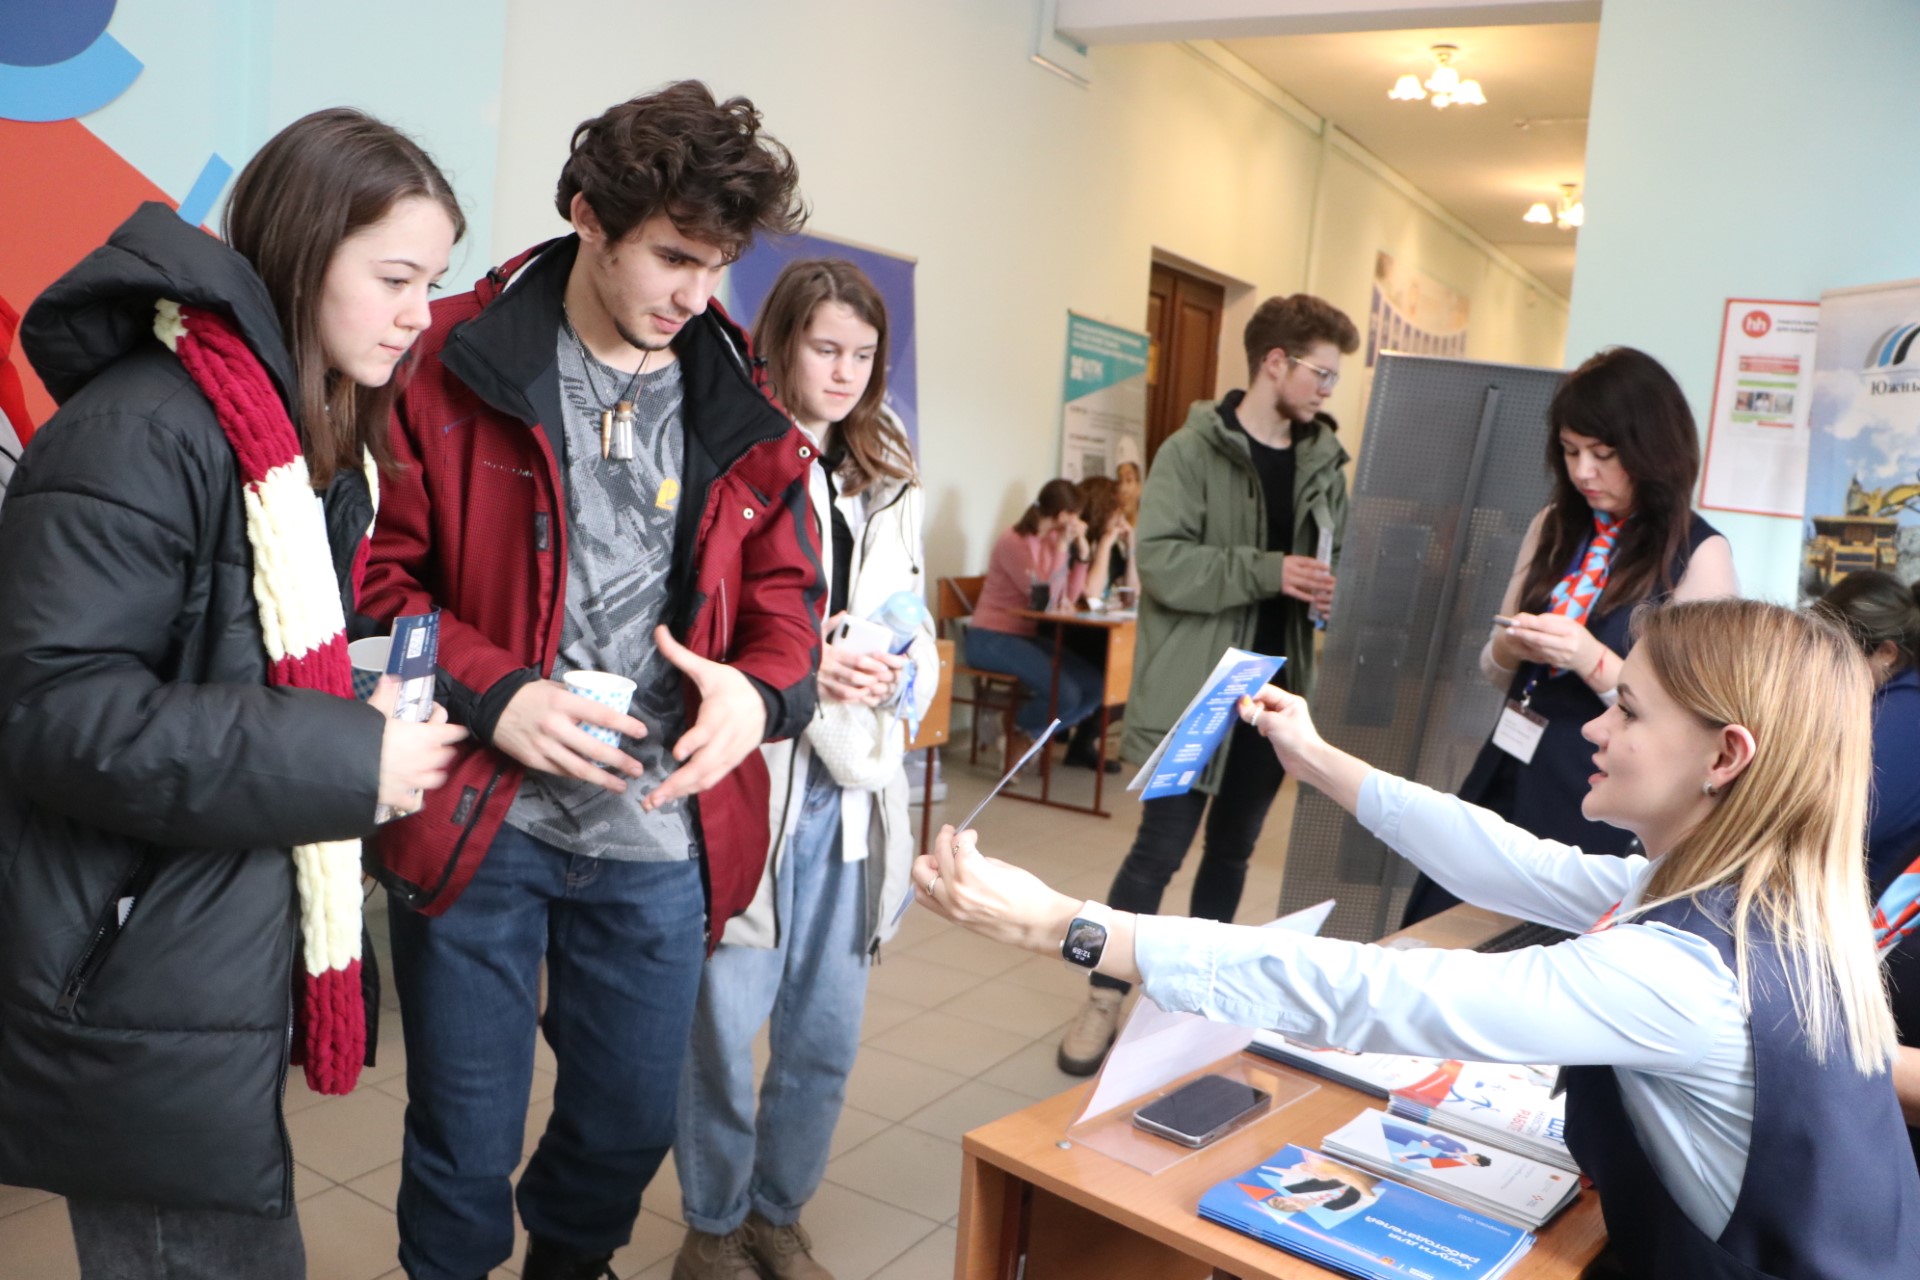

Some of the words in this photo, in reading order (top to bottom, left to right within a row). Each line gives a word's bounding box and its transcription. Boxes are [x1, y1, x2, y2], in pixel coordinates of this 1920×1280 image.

[1746, 315, 1767, 331] hh
[1364, 1216, 1480, 1264] работодателей
[1388, 1233, 1419, 1247] для
[1418, 1244, 1475, 1270] Услуги
